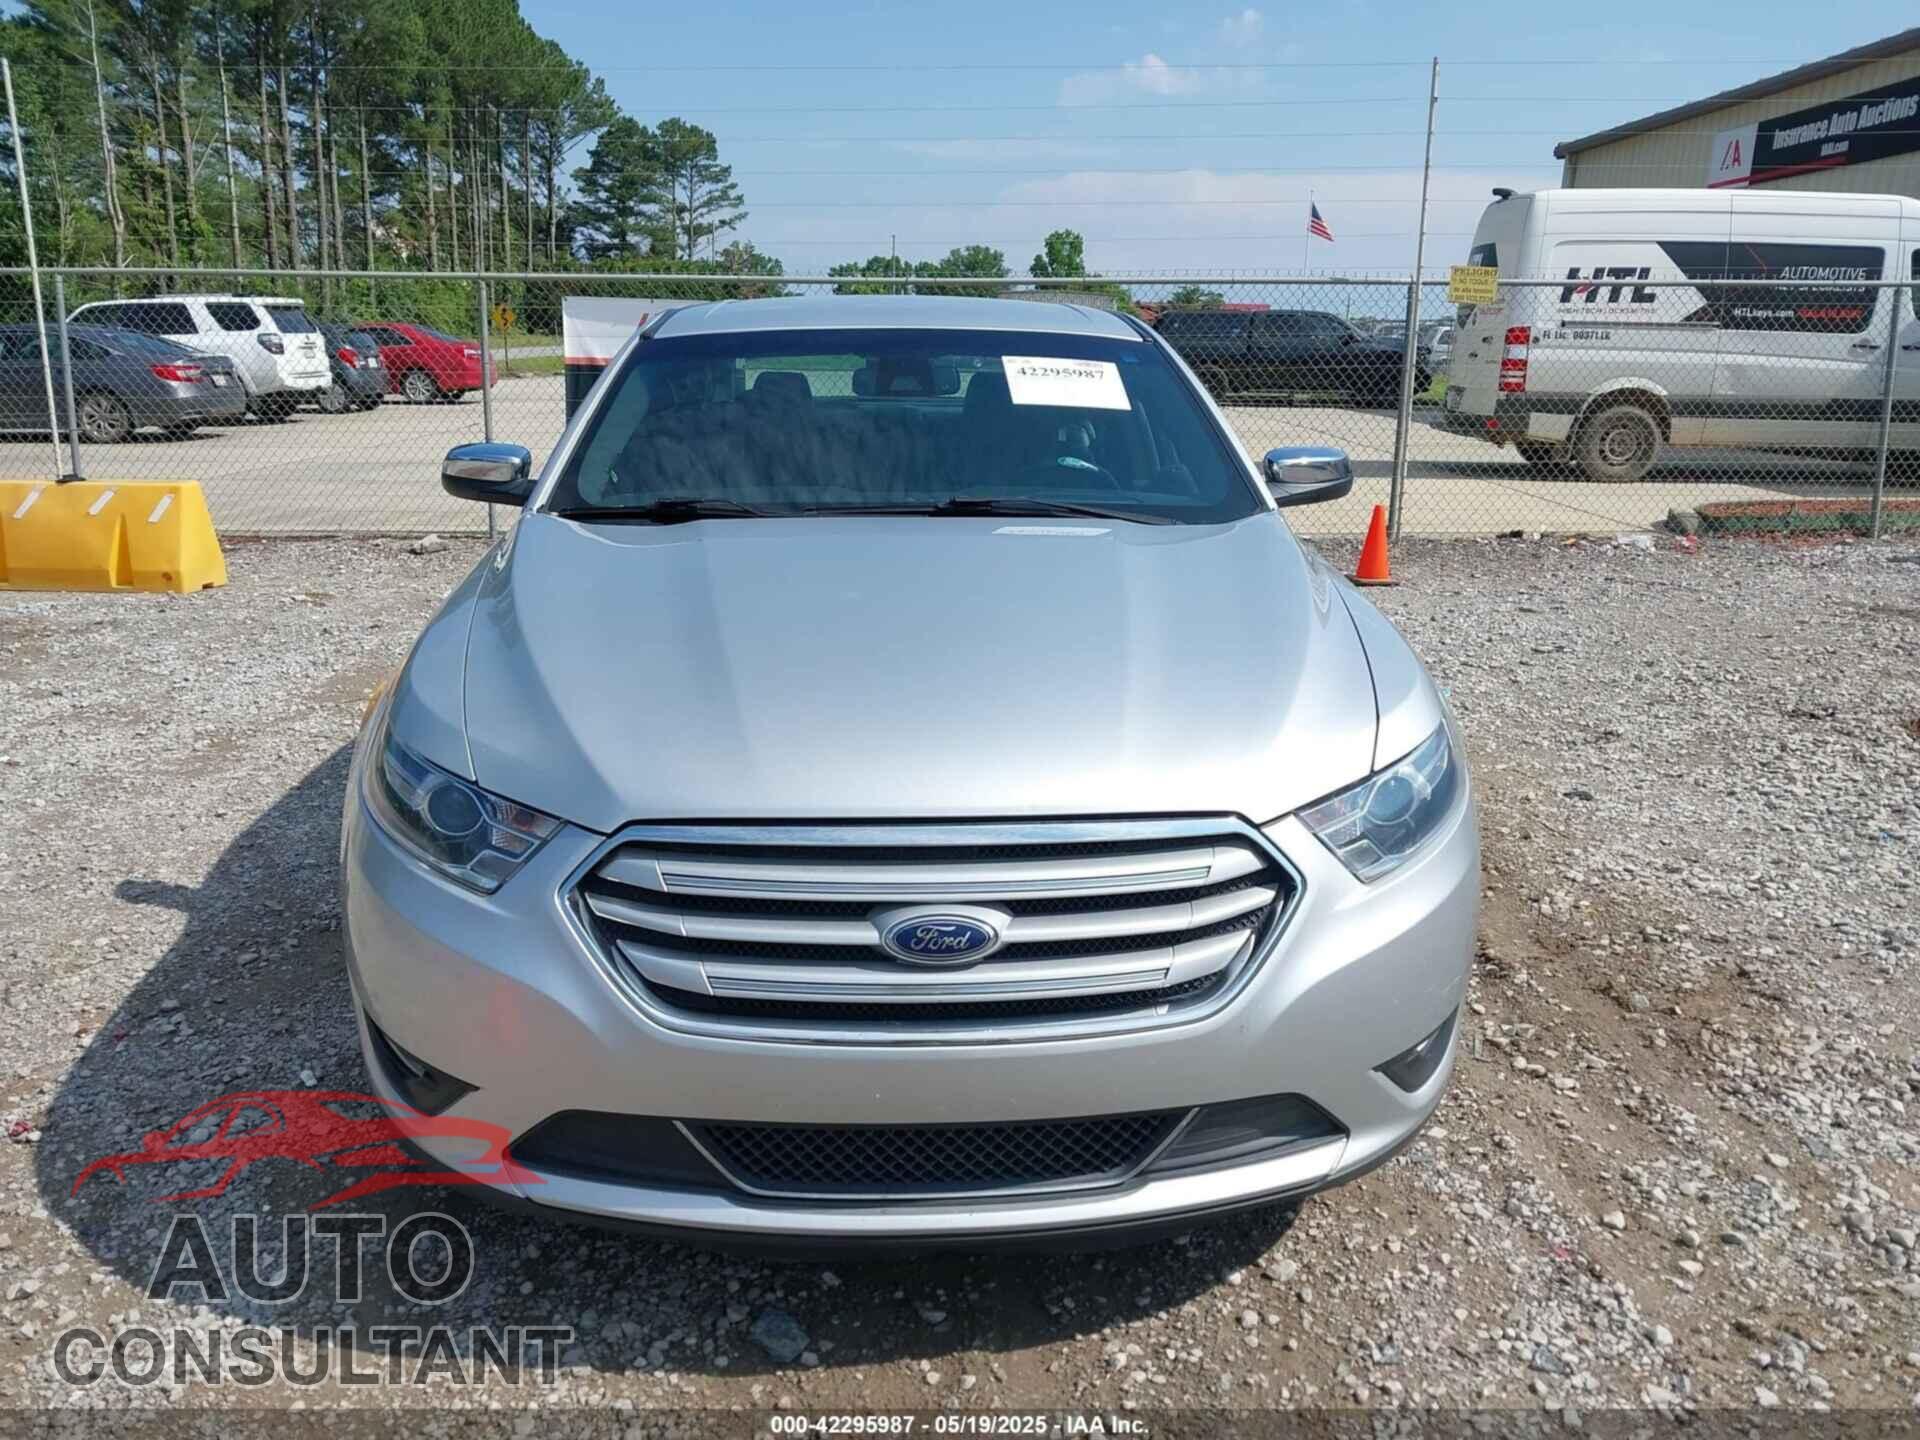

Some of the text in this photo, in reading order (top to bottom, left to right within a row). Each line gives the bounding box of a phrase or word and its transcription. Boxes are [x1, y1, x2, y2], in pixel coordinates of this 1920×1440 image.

[1772, 94, 1920, 150] Insurance Auto Auctions
[1560, 267, 1656, 303] HTL
[1780, 266, 1868, 280] AUTOMOTIVE
[1017, 366, 1104, 380] 42295987
[911, 925, 971, 950] Ford
